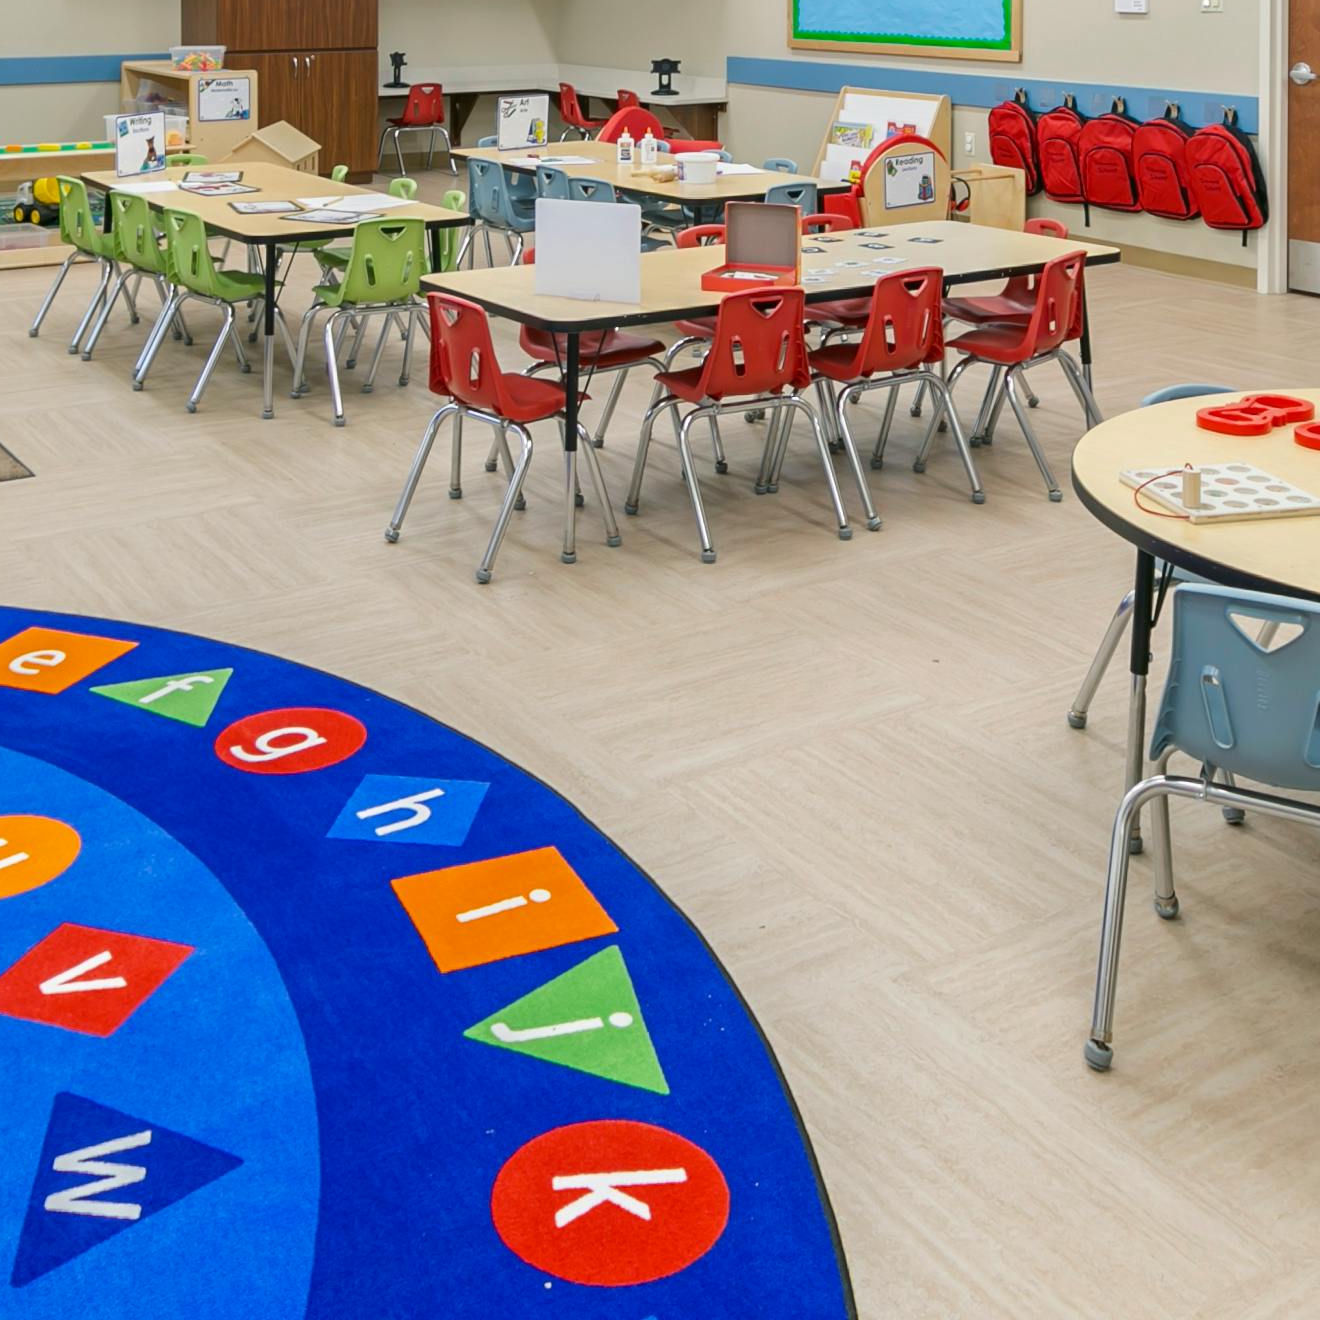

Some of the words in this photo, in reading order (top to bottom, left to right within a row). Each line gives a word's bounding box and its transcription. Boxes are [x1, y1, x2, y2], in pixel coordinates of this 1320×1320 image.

[519, 98, 529, 107] Art
[130, 116, 152, 127] Writing
[895, 156, 924, 167] Reading
[7, 647, 67, 676] e
[138, 674, 215, 704] f
[229, 725, 328, 763] g
[356, 787, 446, 837] h
[456, 887, 552, 923] i
[38, 950, 128, 996] v
[491, 1011, 633, 1043] j
[552, 1167, 687, 1229] k
